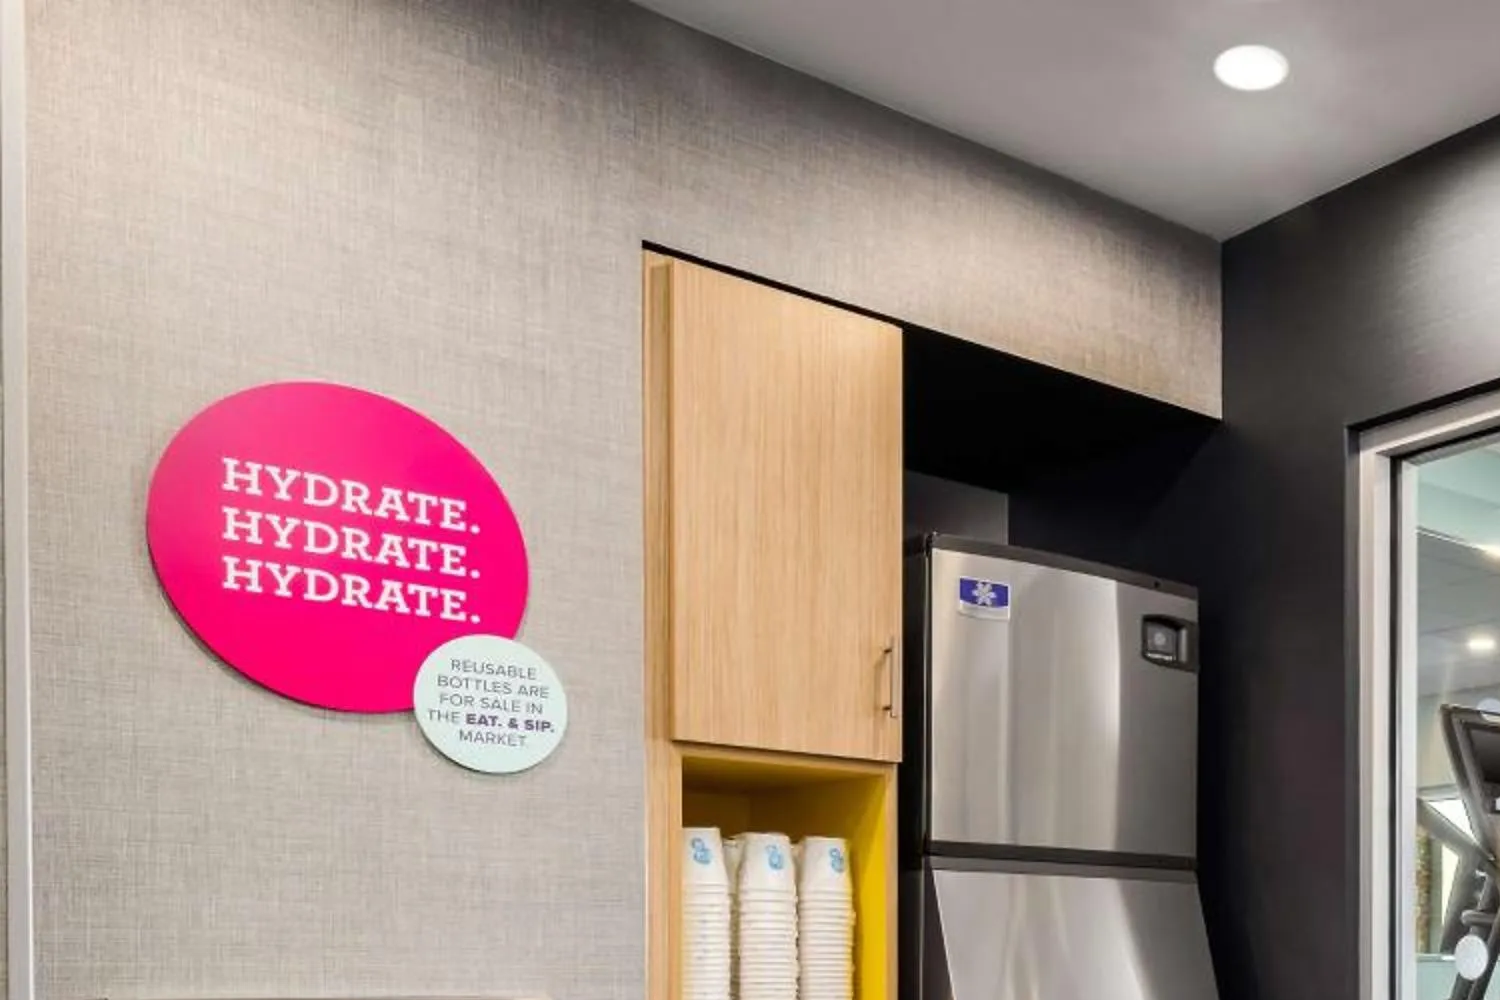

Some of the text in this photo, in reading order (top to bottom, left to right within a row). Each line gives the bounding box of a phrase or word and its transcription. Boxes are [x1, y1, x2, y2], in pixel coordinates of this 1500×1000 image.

[222, 457, 480, 534] HYDRATE.
[222, 506, 480, 579] HYDRATE.
[222, 555, 480, 624] HYDRATE.
[451, 659, 537, 680] REUSABLE
[437, 675, 549, 699] BOTTLES ARE
[439, 693, 543, 715] FOR SALE IN
[428, 709, 555, 733] THE EAT. & SIP.
[459, 729, 527, 747] MARKET
